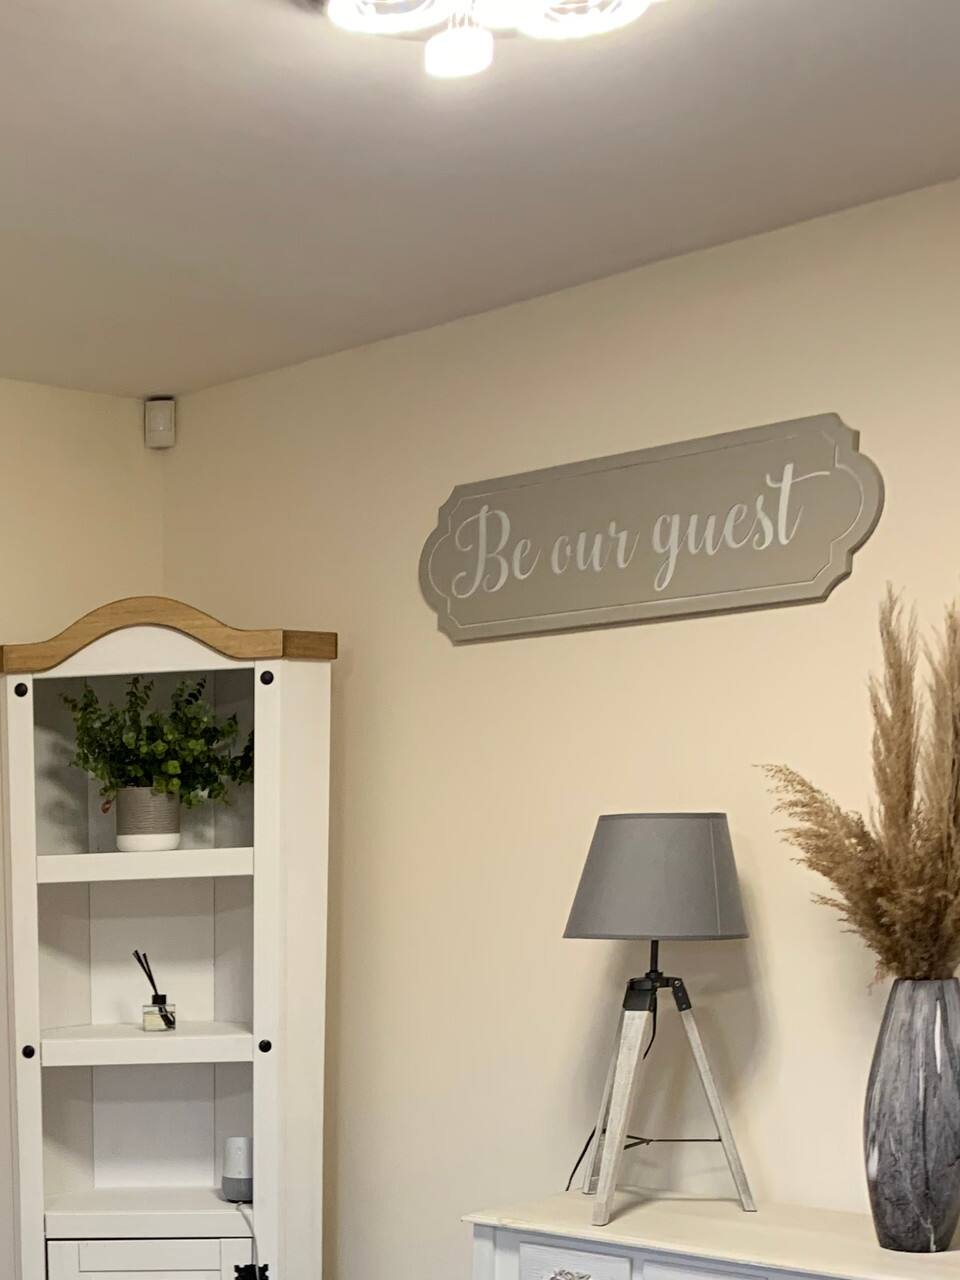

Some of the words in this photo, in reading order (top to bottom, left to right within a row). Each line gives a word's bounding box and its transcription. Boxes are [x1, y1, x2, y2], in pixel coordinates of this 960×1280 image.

[451, 504, 541, 599] Be
[550, 520, 639, 575] our
[651, 462, 831, 592] guest
